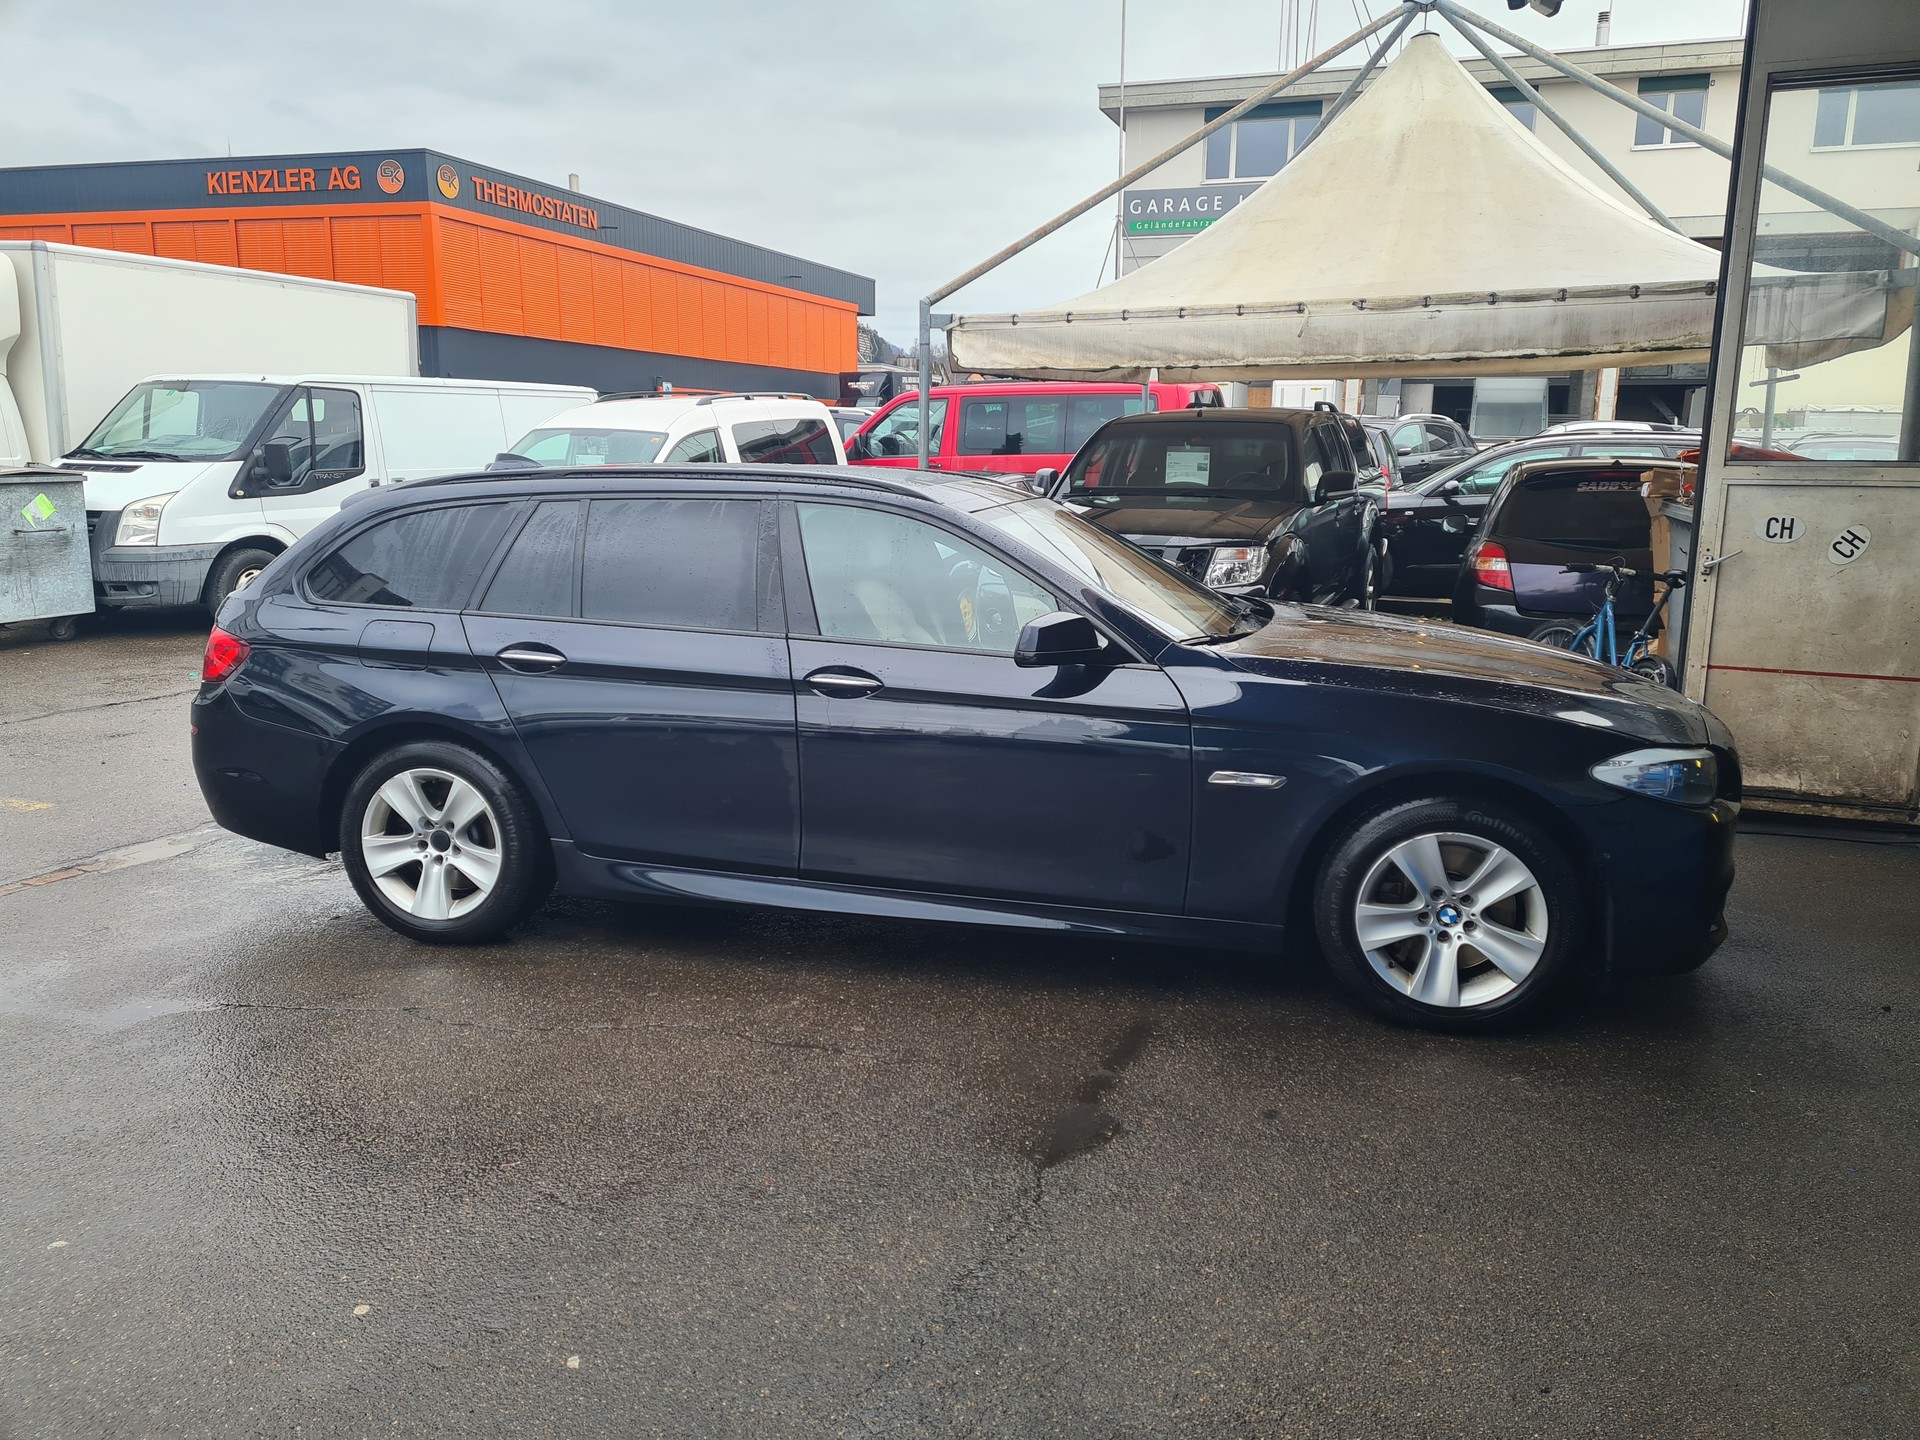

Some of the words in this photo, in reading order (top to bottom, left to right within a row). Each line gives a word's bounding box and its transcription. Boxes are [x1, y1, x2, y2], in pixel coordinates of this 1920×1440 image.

[207, 168, 316, 195] KIENZLER
[328, 165, 361, 191] AG
[471, 176, 599, 231] THERMOSTATEN
[1129, 195, 1223, 215] GARAGE
[1765, 517, 1795, 539] CH
[1832, 529, 1867, 559] CH
